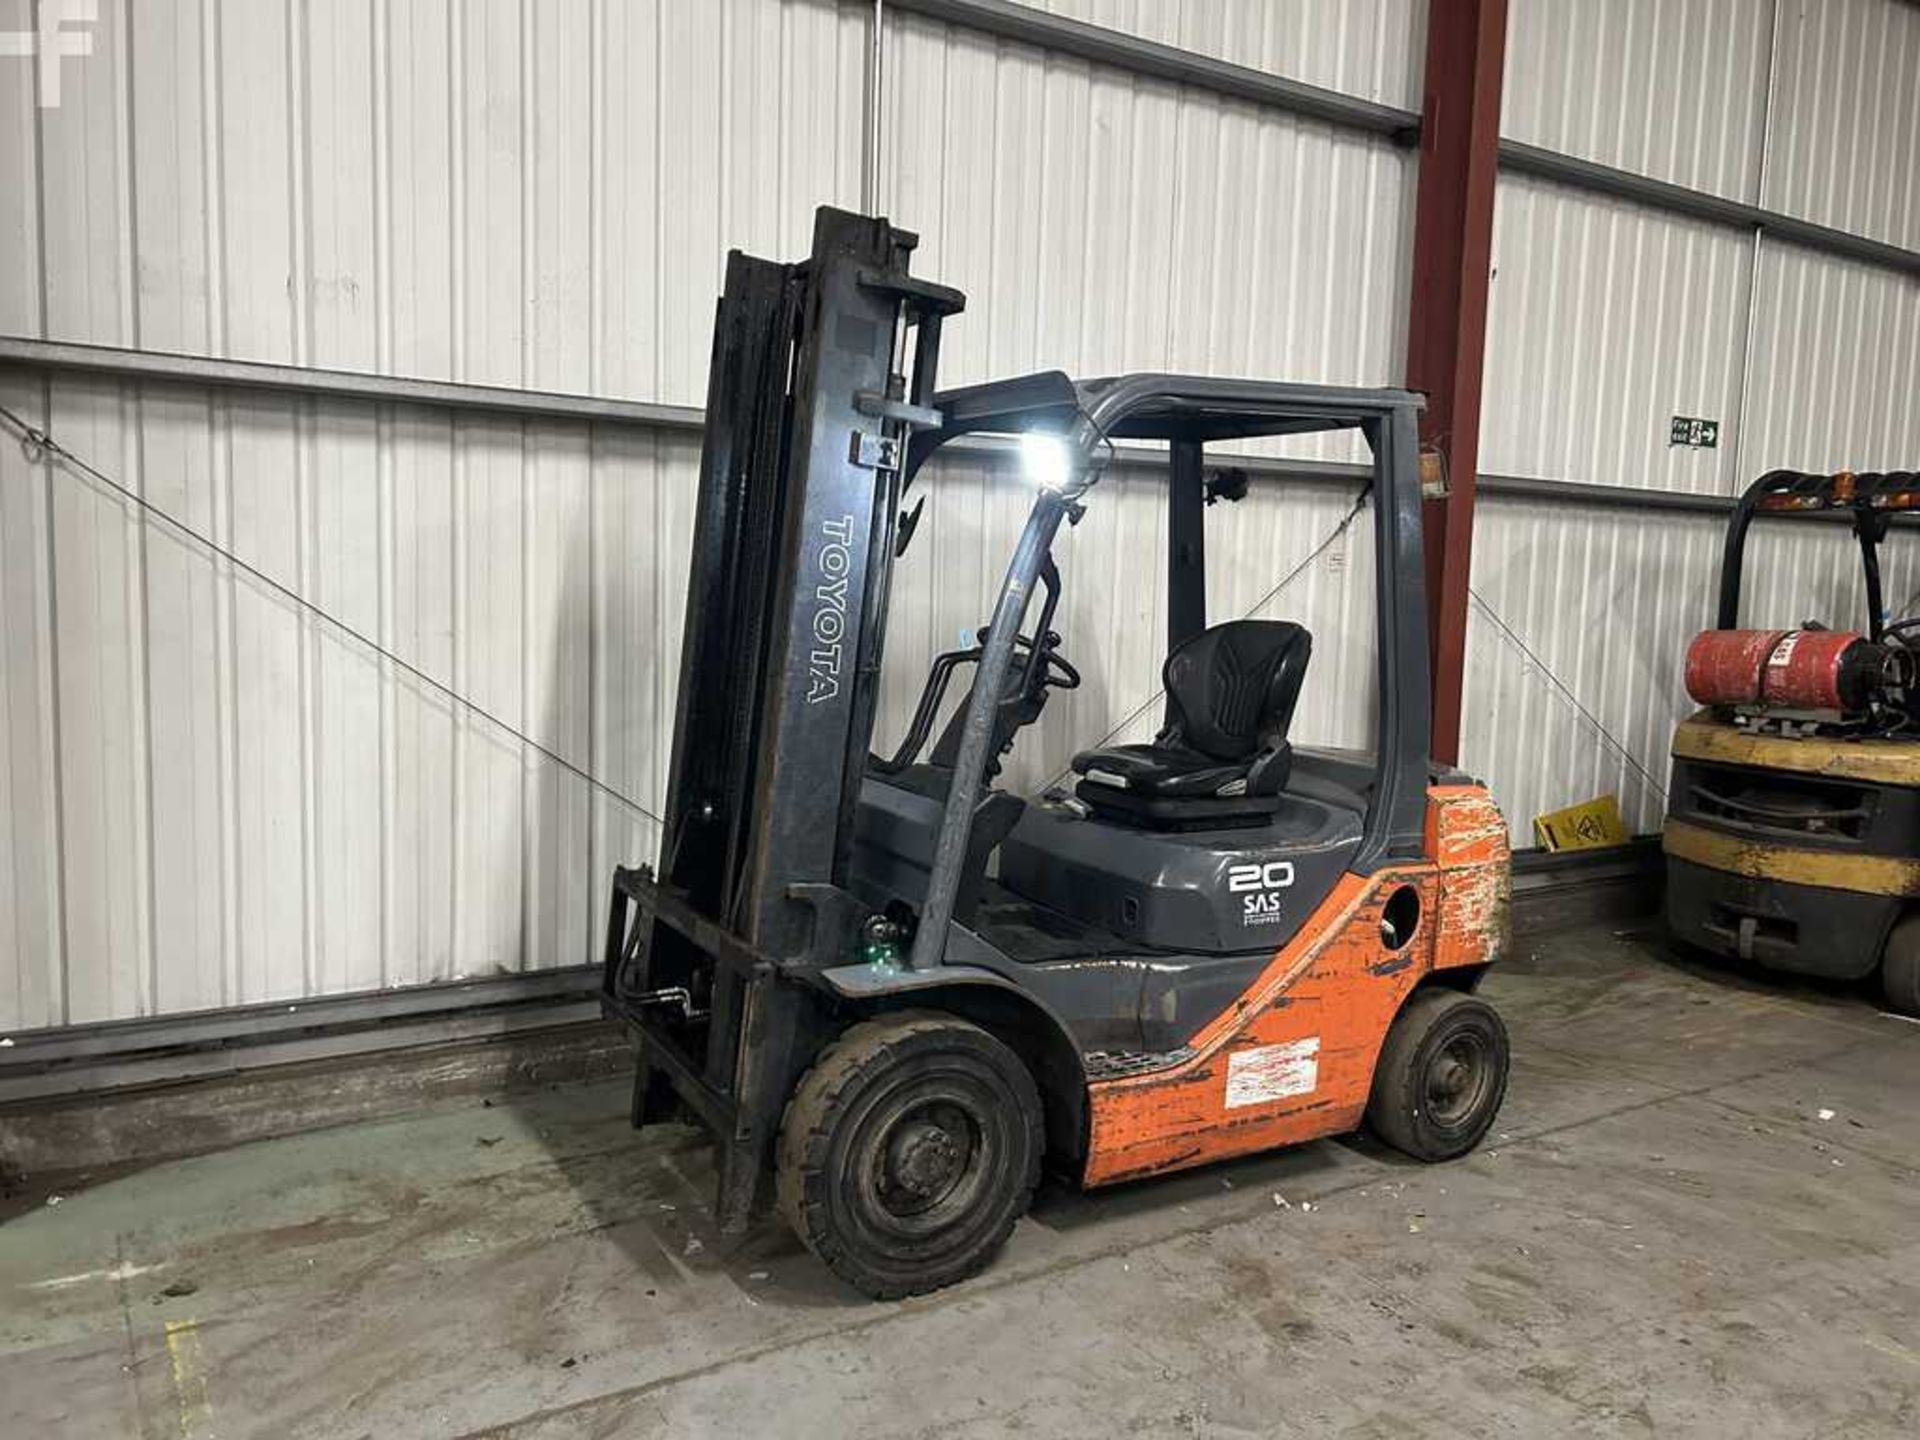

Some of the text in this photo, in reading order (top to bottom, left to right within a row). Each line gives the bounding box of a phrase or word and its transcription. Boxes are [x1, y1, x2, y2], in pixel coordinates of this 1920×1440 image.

[807, 515, 854, 704] TOYOTA
[1228, 861, 1295, 892] 20
[1244, 892, 1280, 914] SAS
